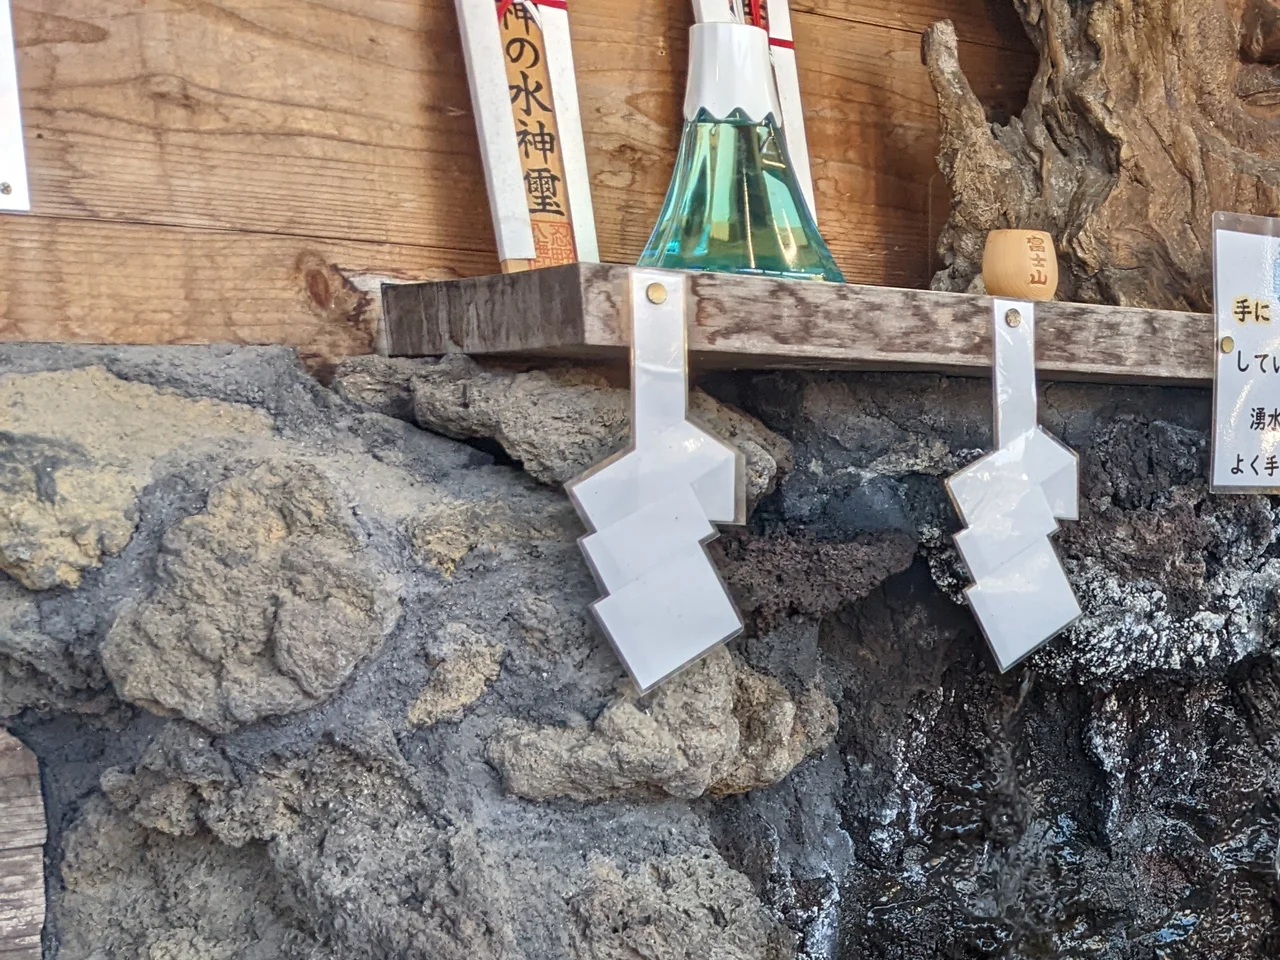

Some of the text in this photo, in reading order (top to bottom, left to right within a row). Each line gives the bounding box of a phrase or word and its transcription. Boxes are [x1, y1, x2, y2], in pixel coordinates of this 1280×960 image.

[1026, 235, 1048, 285] 富士山
[1234, 299, 1271, 323] 手に
